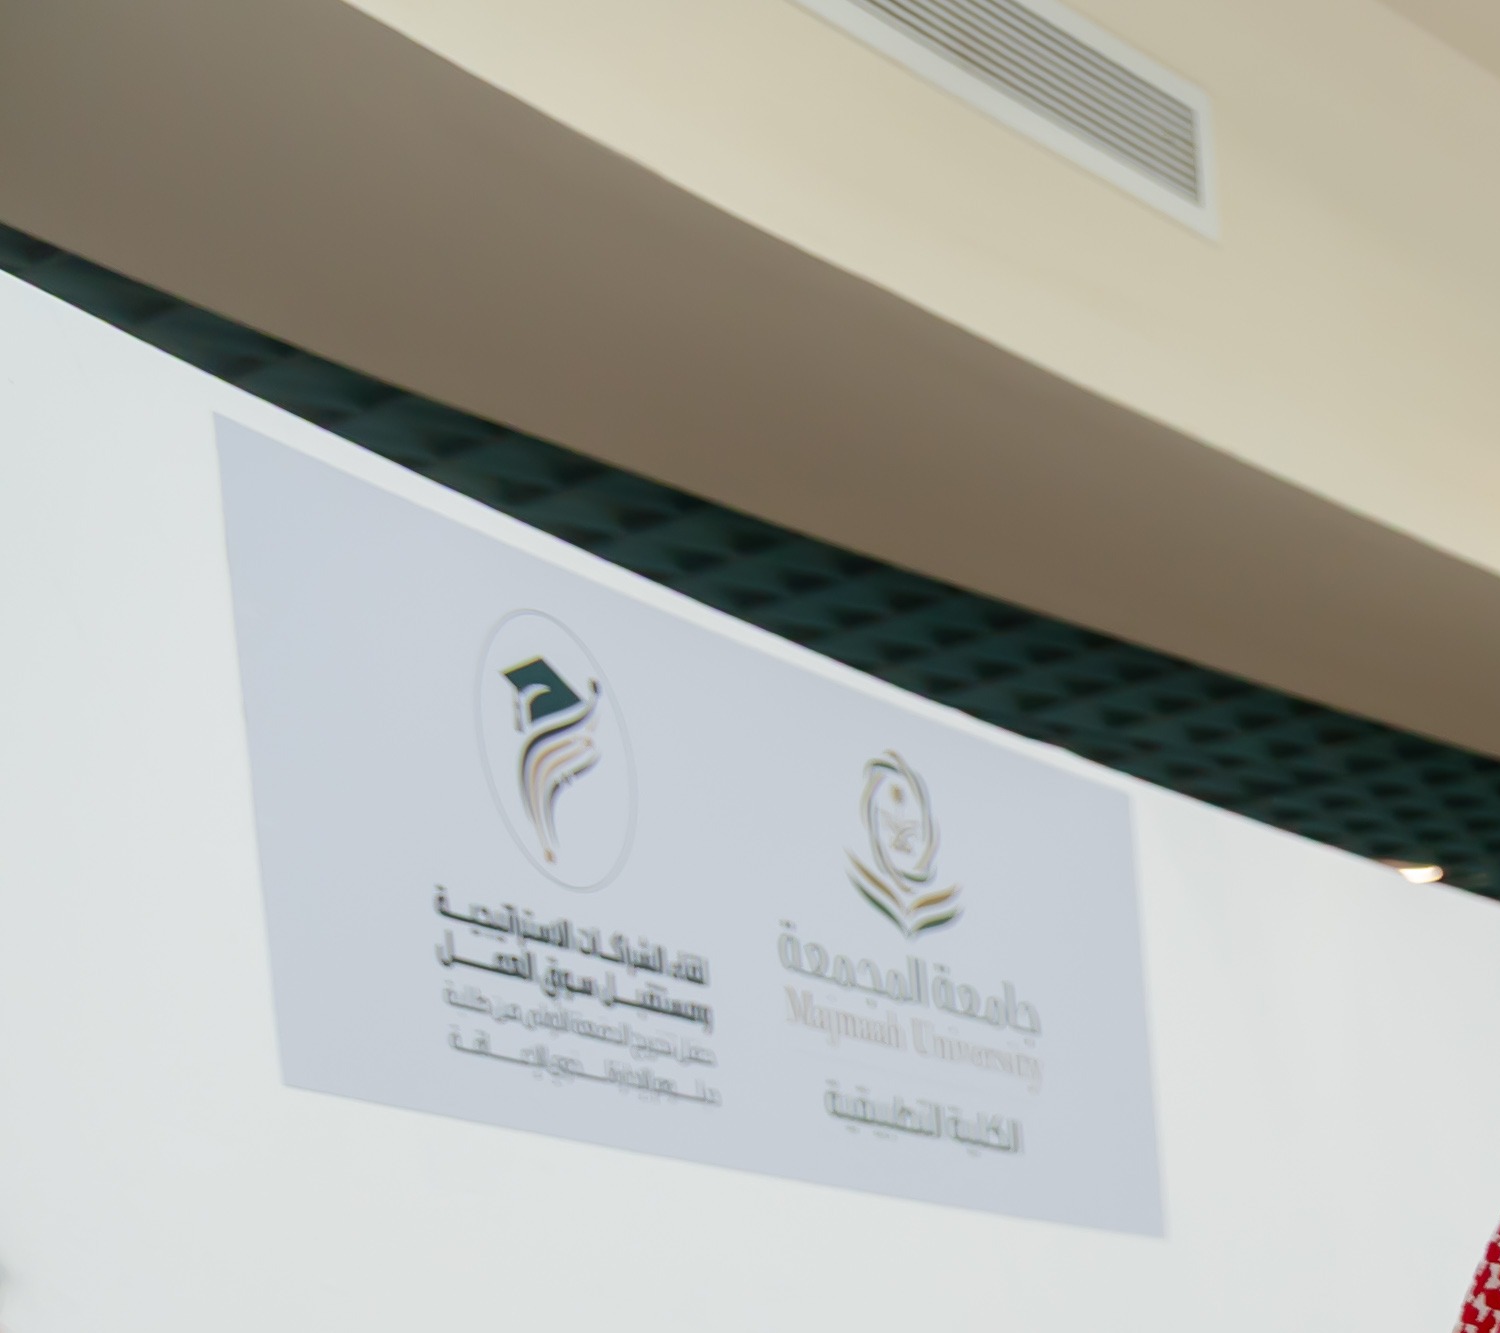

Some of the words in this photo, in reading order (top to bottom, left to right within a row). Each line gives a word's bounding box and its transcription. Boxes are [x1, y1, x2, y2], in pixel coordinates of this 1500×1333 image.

[436, 929, 537, 982] العمل
[541, 956, 597, 1000] سوق
[778, 919, 931, 1009] المجمعة
[783, 985, 907, 1050] Majmaah
[932, 962, 1042, 1049] جامعة
[945, 1104, 1026, 1158] الكلية
